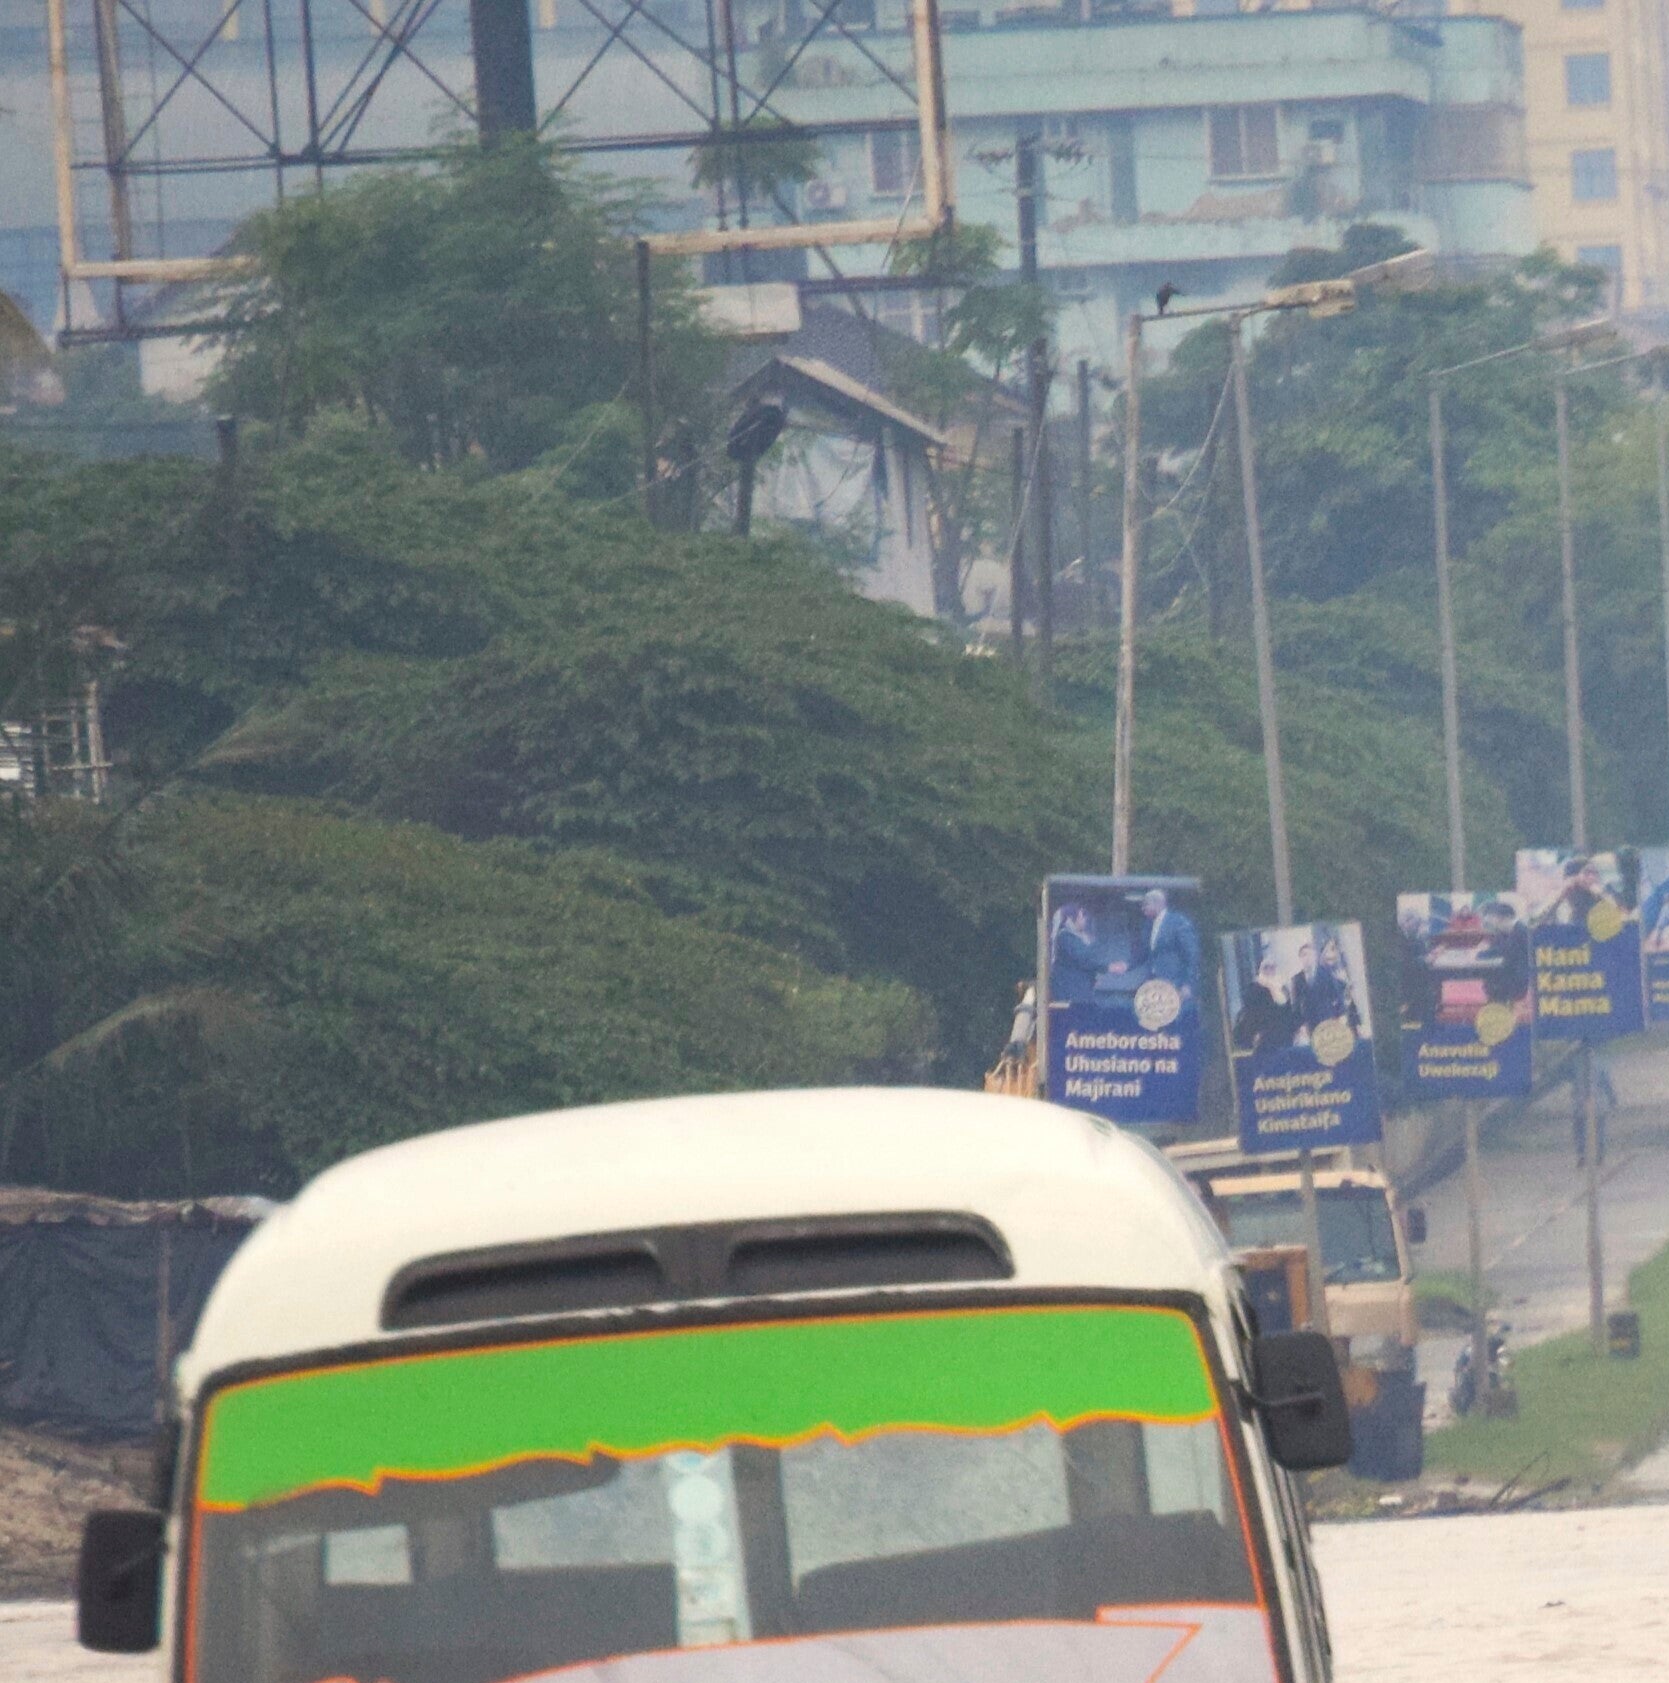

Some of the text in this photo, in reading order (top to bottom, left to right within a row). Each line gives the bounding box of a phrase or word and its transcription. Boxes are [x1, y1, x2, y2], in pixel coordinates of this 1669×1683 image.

[1536, 943, 1590, 967] Nani
[1537, 971, 1605, 992] Kama
[1538, 996, 1612, 1017] Mama
[1065, 1032, 1181, 1050] Ameboresha
[1065, 1055, 1179, 1073] Uhusiano na
[1418, 1062, 1498, 1081] Uwekezaji
[1065, 1078, 1143, 1102] Majirani
[1253, 1070, 1334, 1092] Anajenga
[1254, 1090, 1352, 1114] Ushirikiano
[1257, 1110, 1342, 1134] Kimataifa
